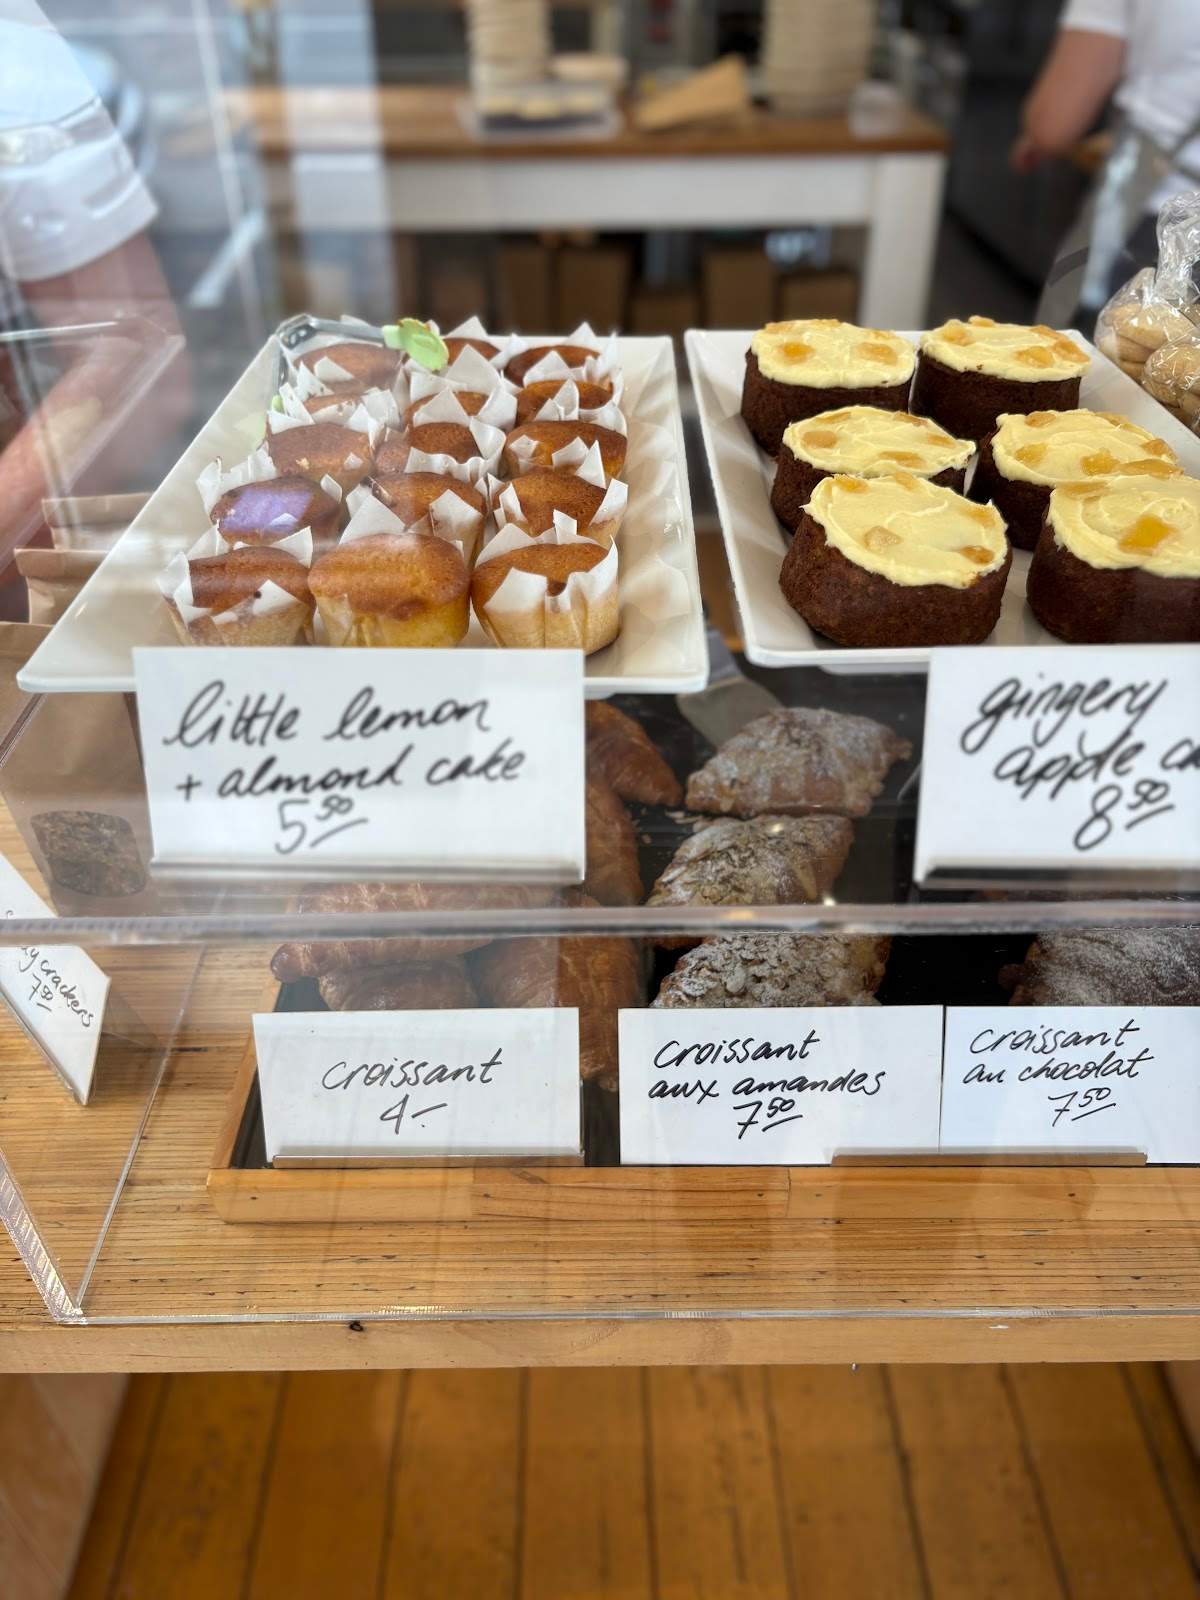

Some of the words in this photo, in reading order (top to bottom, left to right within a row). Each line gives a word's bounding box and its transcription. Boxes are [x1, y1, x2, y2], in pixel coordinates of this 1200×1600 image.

[162, 680, 301, 748] little
[323, 686, 492, 741] lemon
[960, 672, 1168, 755] gingery
[175, 774, 202, 801] +
[217, 744, 413, 798] almond
[425, 737, 526, 786] cake
[993, 727, 1145, 801] apple
[40, 958, 94, 1028] crackers
[321, 1047, 503, 1090] croissant
[648, 1079, 720, 1104] aux
[732, 1068, 886, 1096] amandes
[962, 1063, 1008, 1084] au
[1018, 1047, 1155, 1082] chocolat
